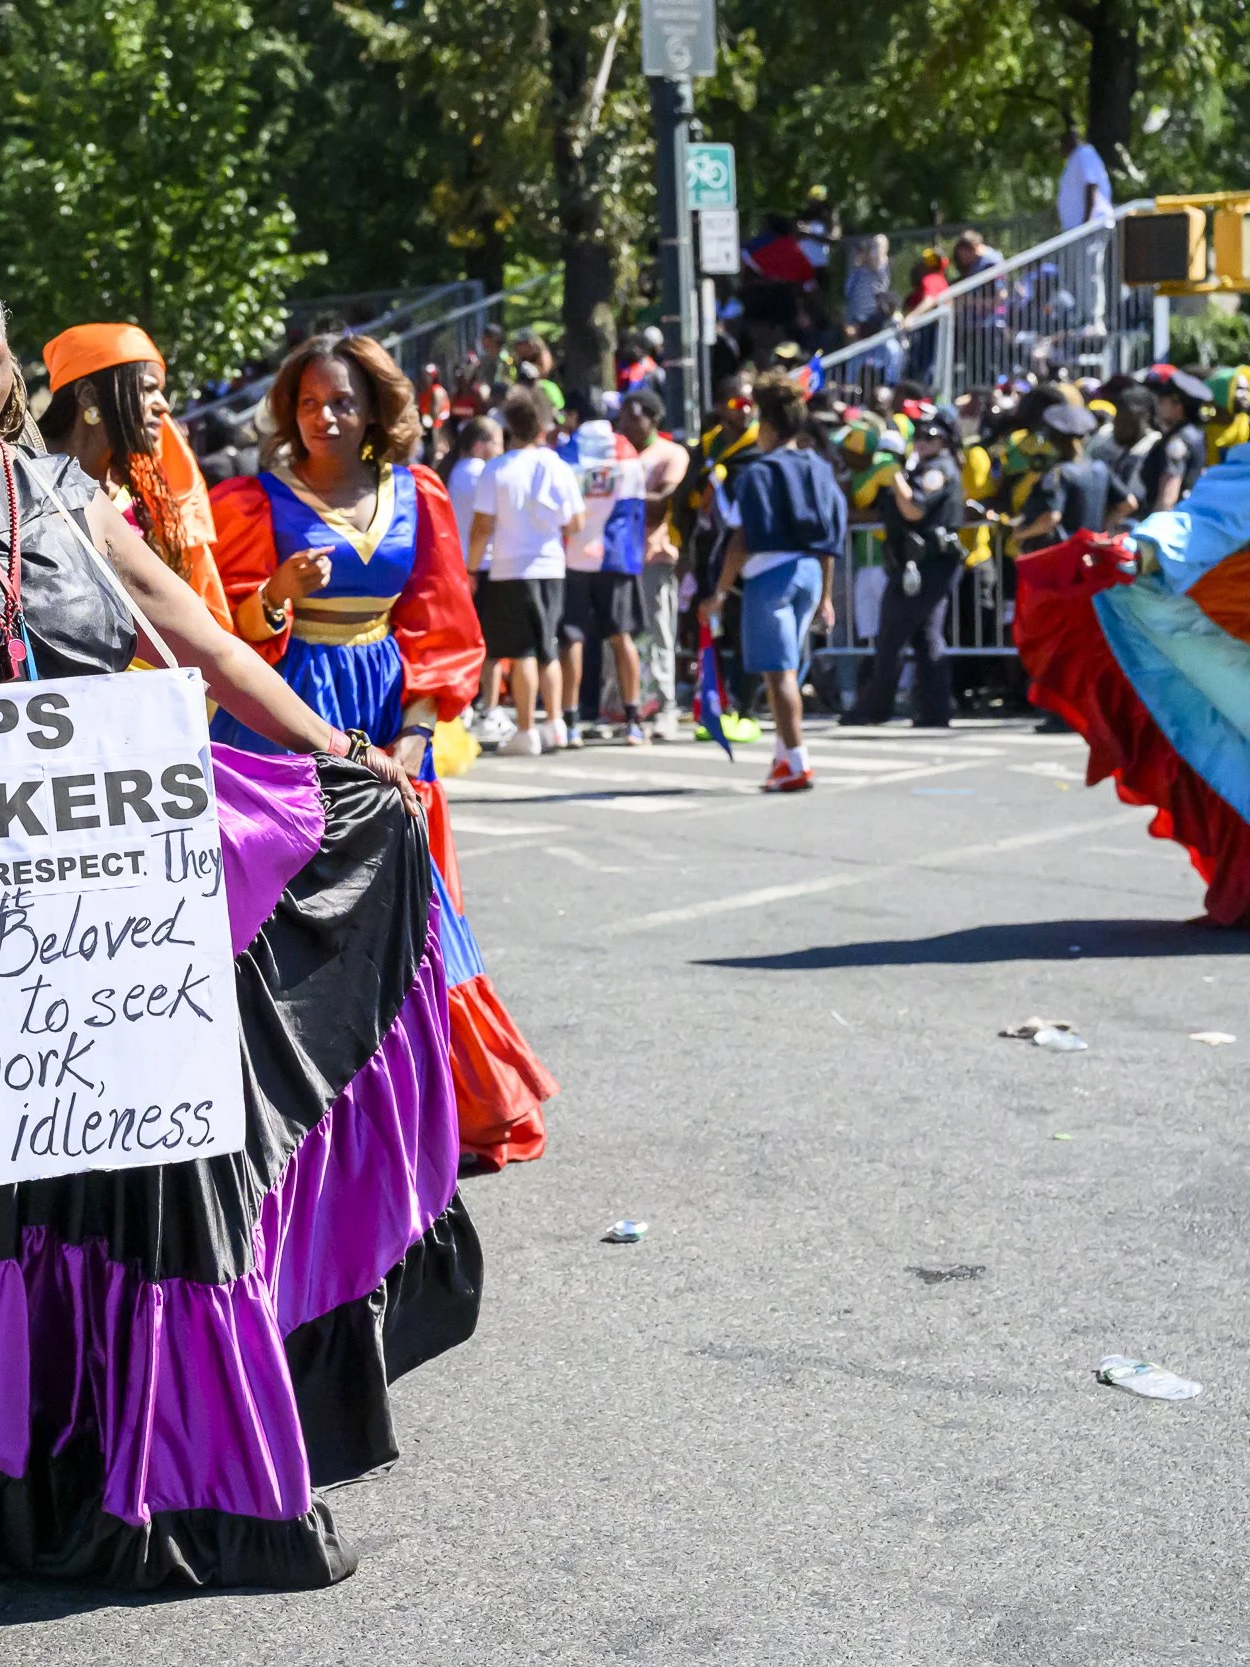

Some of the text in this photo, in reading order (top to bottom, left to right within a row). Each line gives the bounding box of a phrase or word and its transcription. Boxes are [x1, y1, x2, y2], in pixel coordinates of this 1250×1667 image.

[151, 827, 223, 898] They
[20, 974, 70, 1035] to
[84, 963, 214, 1028] seek
